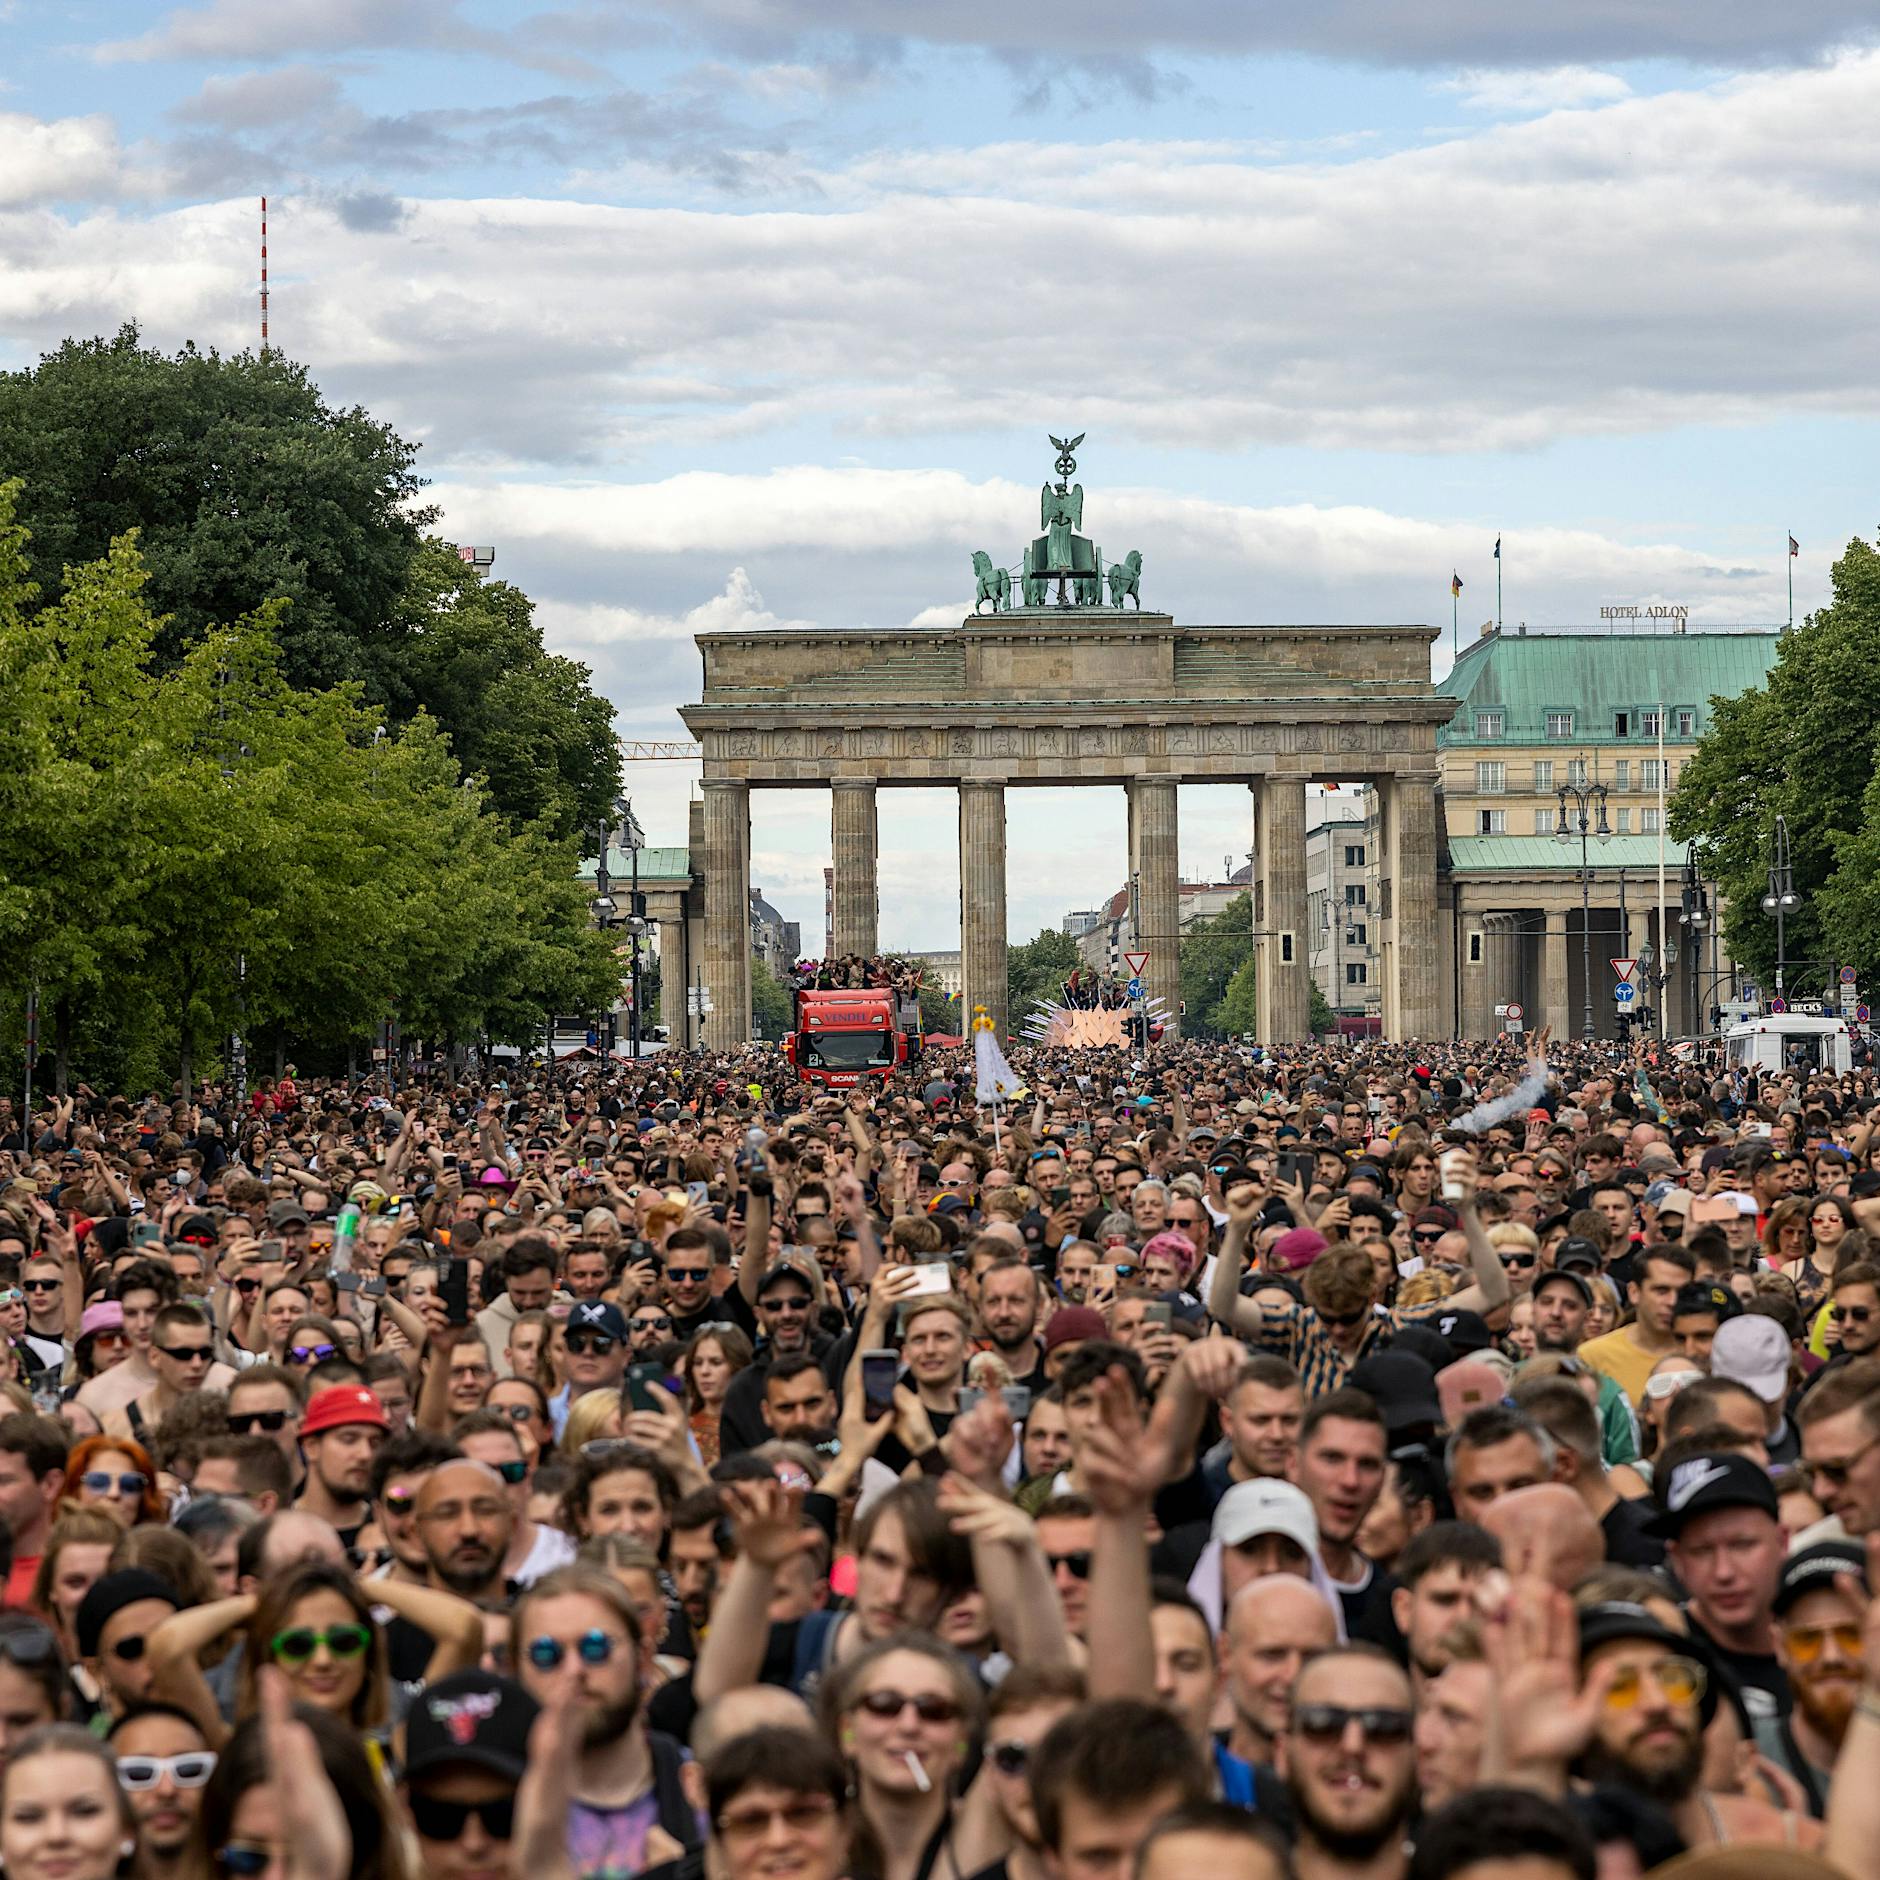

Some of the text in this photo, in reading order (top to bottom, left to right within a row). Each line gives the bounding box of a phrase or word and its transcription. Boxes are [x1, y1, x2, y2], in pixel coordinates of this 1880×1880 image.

[1600, 606, 1688, 618] HOTEL ADLON
[810, 1055, 817, 1063] 2
